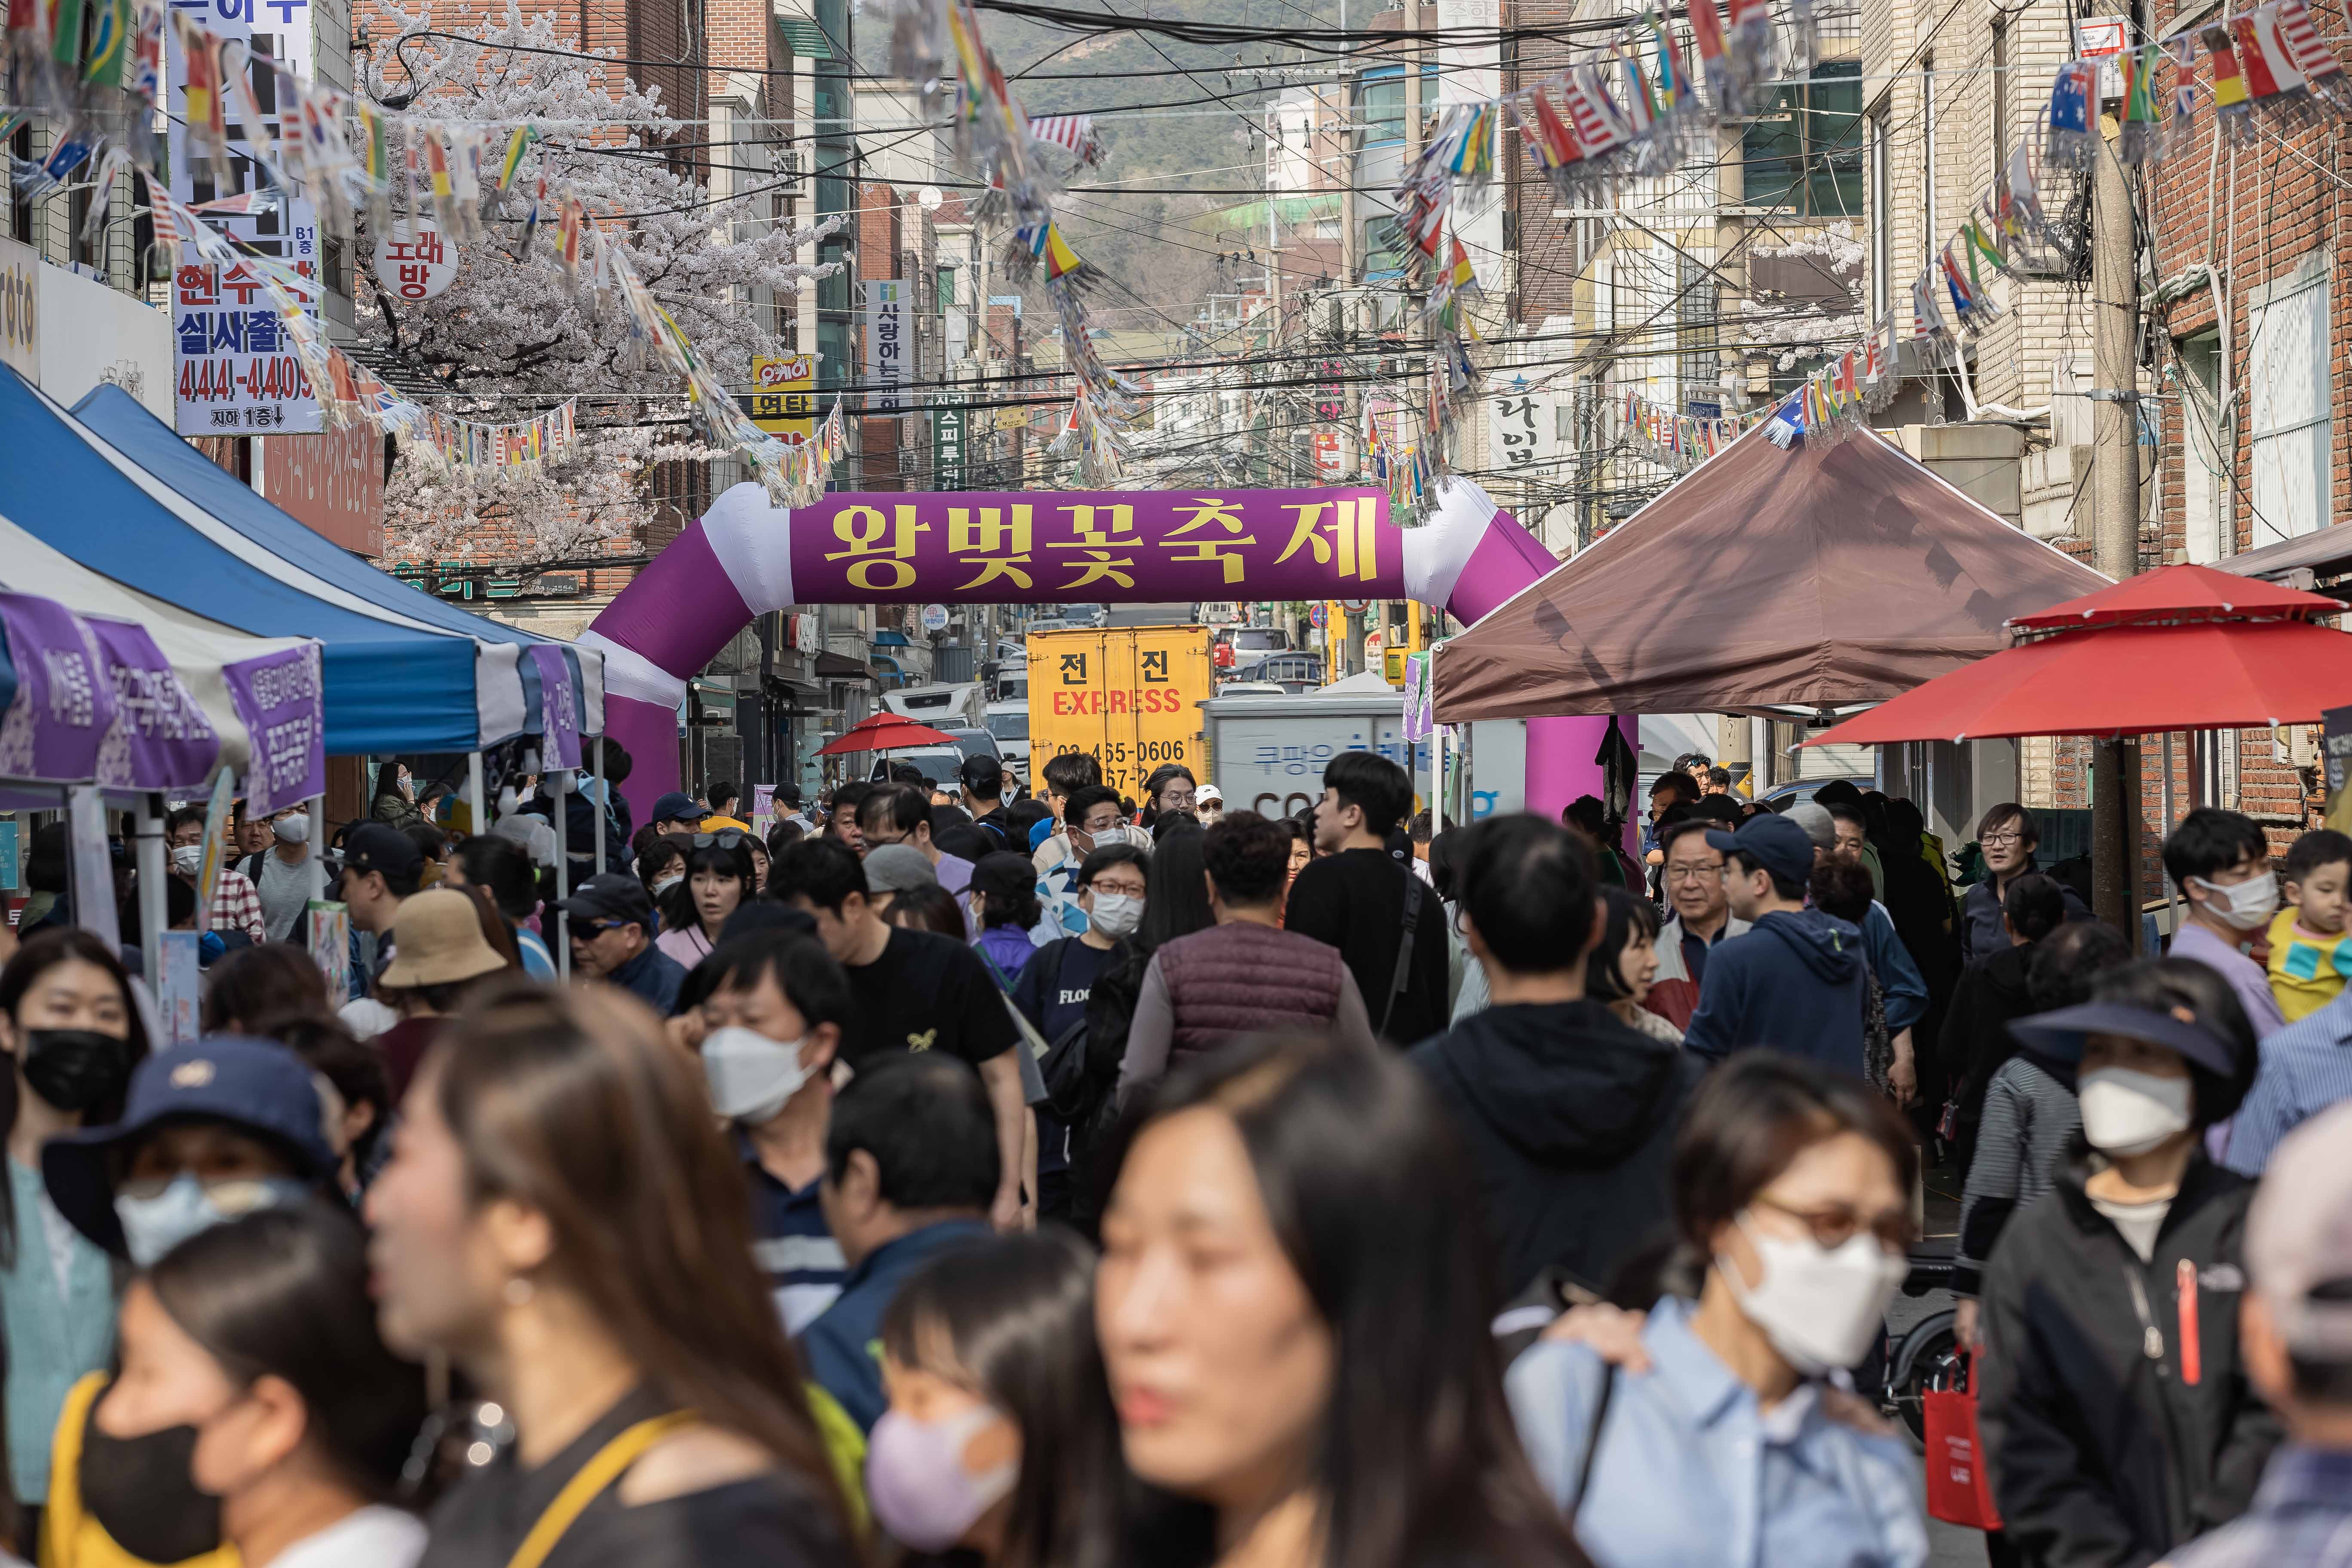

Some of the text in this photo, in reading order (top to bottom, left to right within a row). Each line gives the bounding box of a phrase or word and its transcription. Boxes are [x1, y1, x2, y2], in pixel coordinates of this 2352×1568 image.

[295, 227, 313, 239] B1
[299, 240, 312, 254] 층
[386, 231, 444, 264] 노래
[399, 264, 430, 298] 방
[177, 309, 318, 355] 실사출
[760, 360, 809, 385] 오케이
[877, 303, 901, 415] 사랑하는교회
[179, 355, 315, 402] 444-4409
[211, 406, 273, 427] 지하 1층
[1495, 397, 1540, 468] 라이브
[1053, 688, 1181, 715] EXPRESS
[1254, 744, 1333, 775] 쿠팡은
